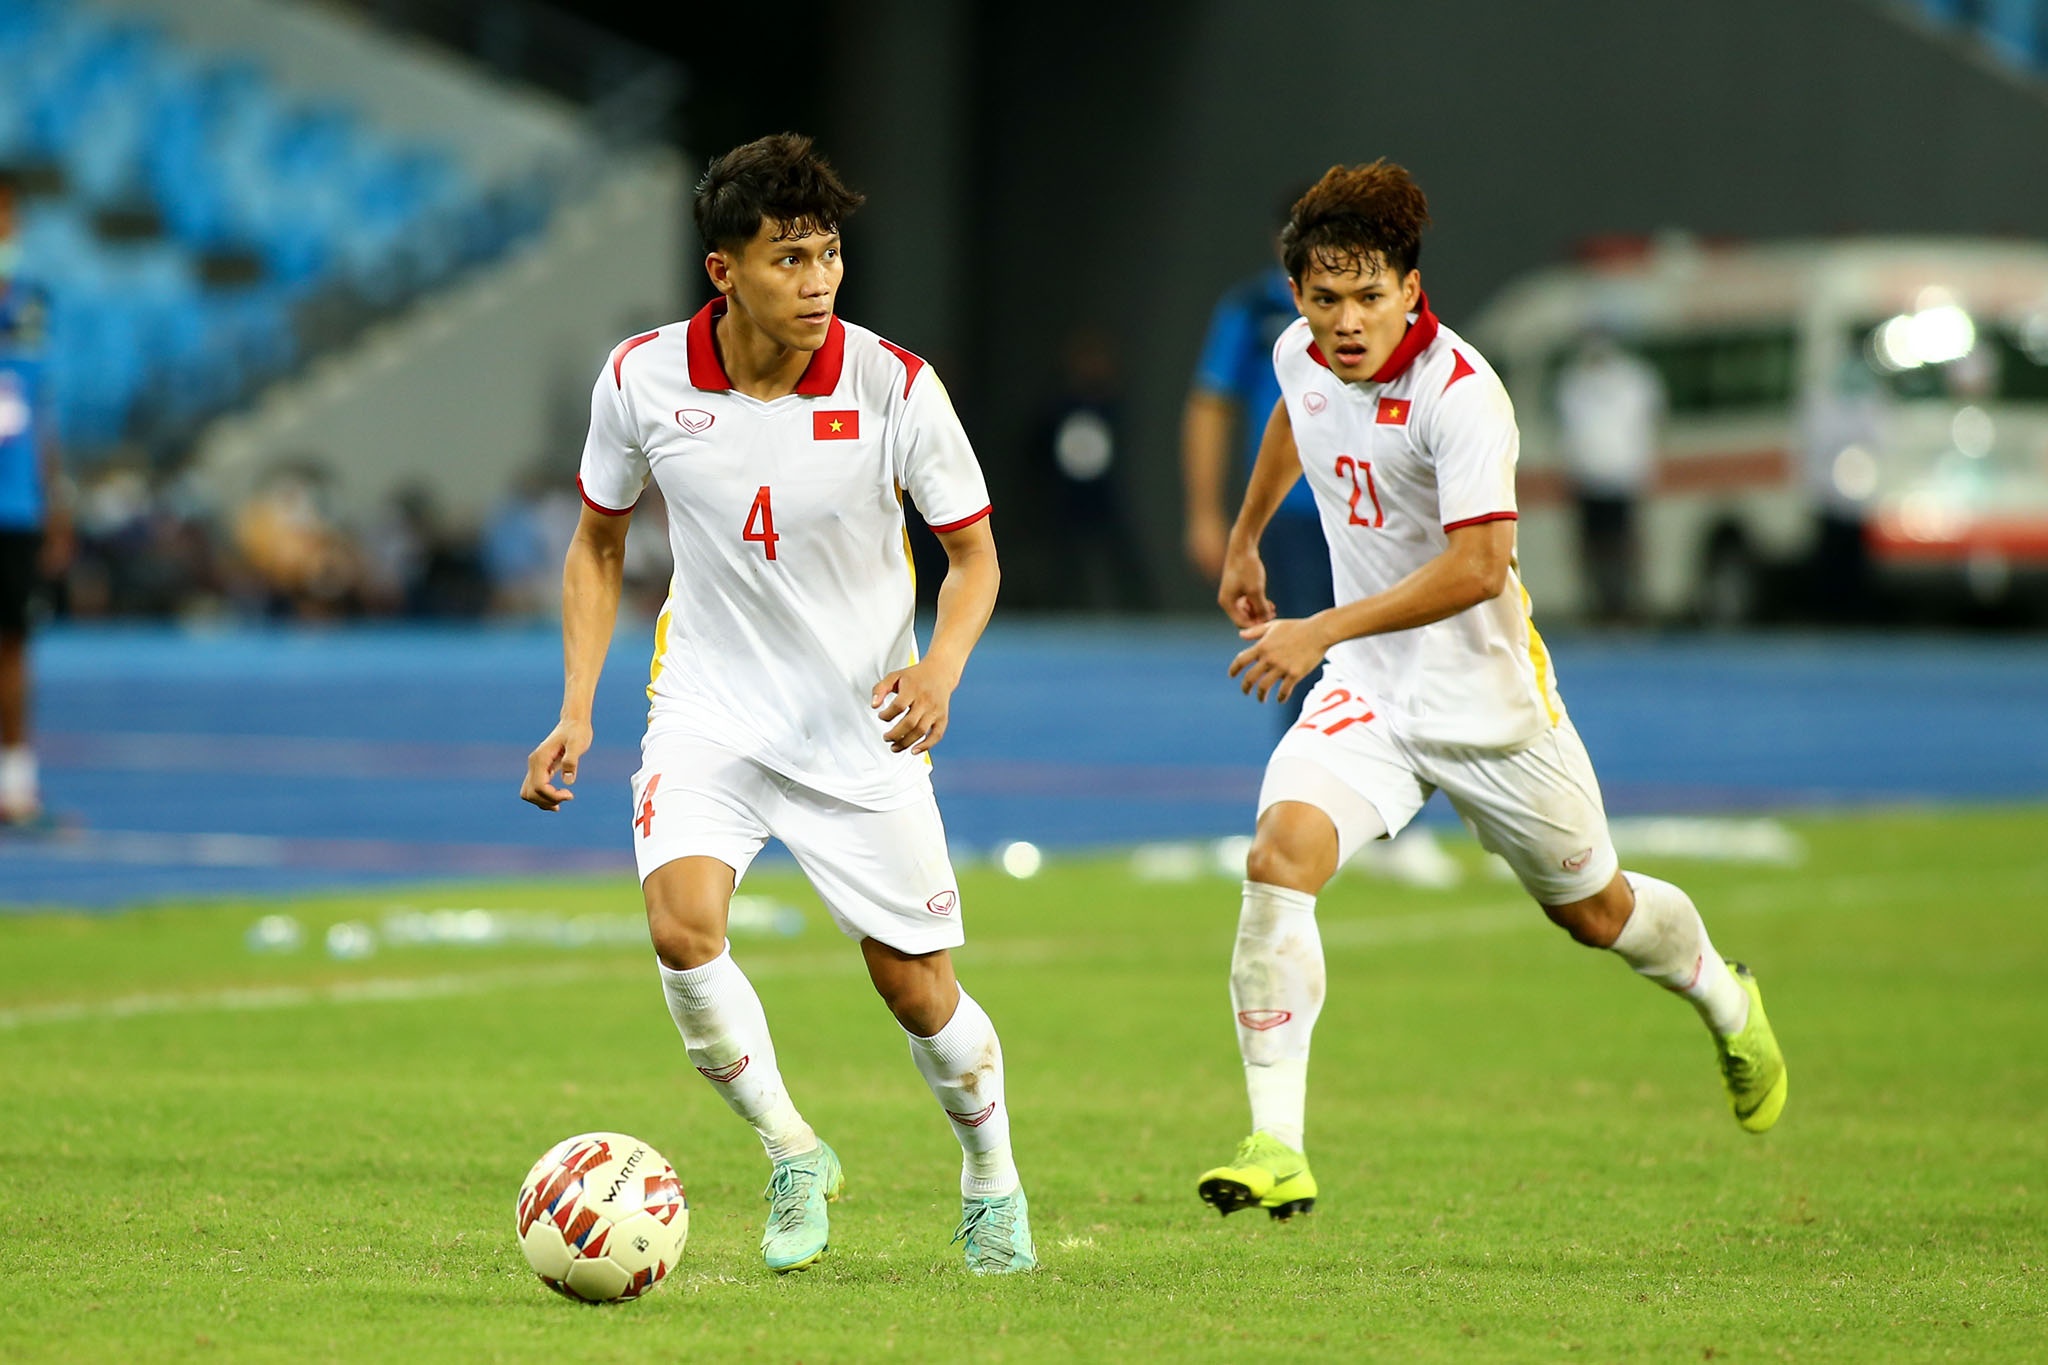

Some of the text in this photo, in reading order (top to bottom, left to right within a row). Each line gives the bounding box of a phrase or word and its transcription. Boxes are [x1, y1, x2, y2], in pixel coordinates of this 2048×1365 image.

[742, 485, 780, 561] 4
[1334, 454, 1385, 528] 21
[635, 773, 662, 839] 4
[602, 1147, 646, 1203] WARRIX
